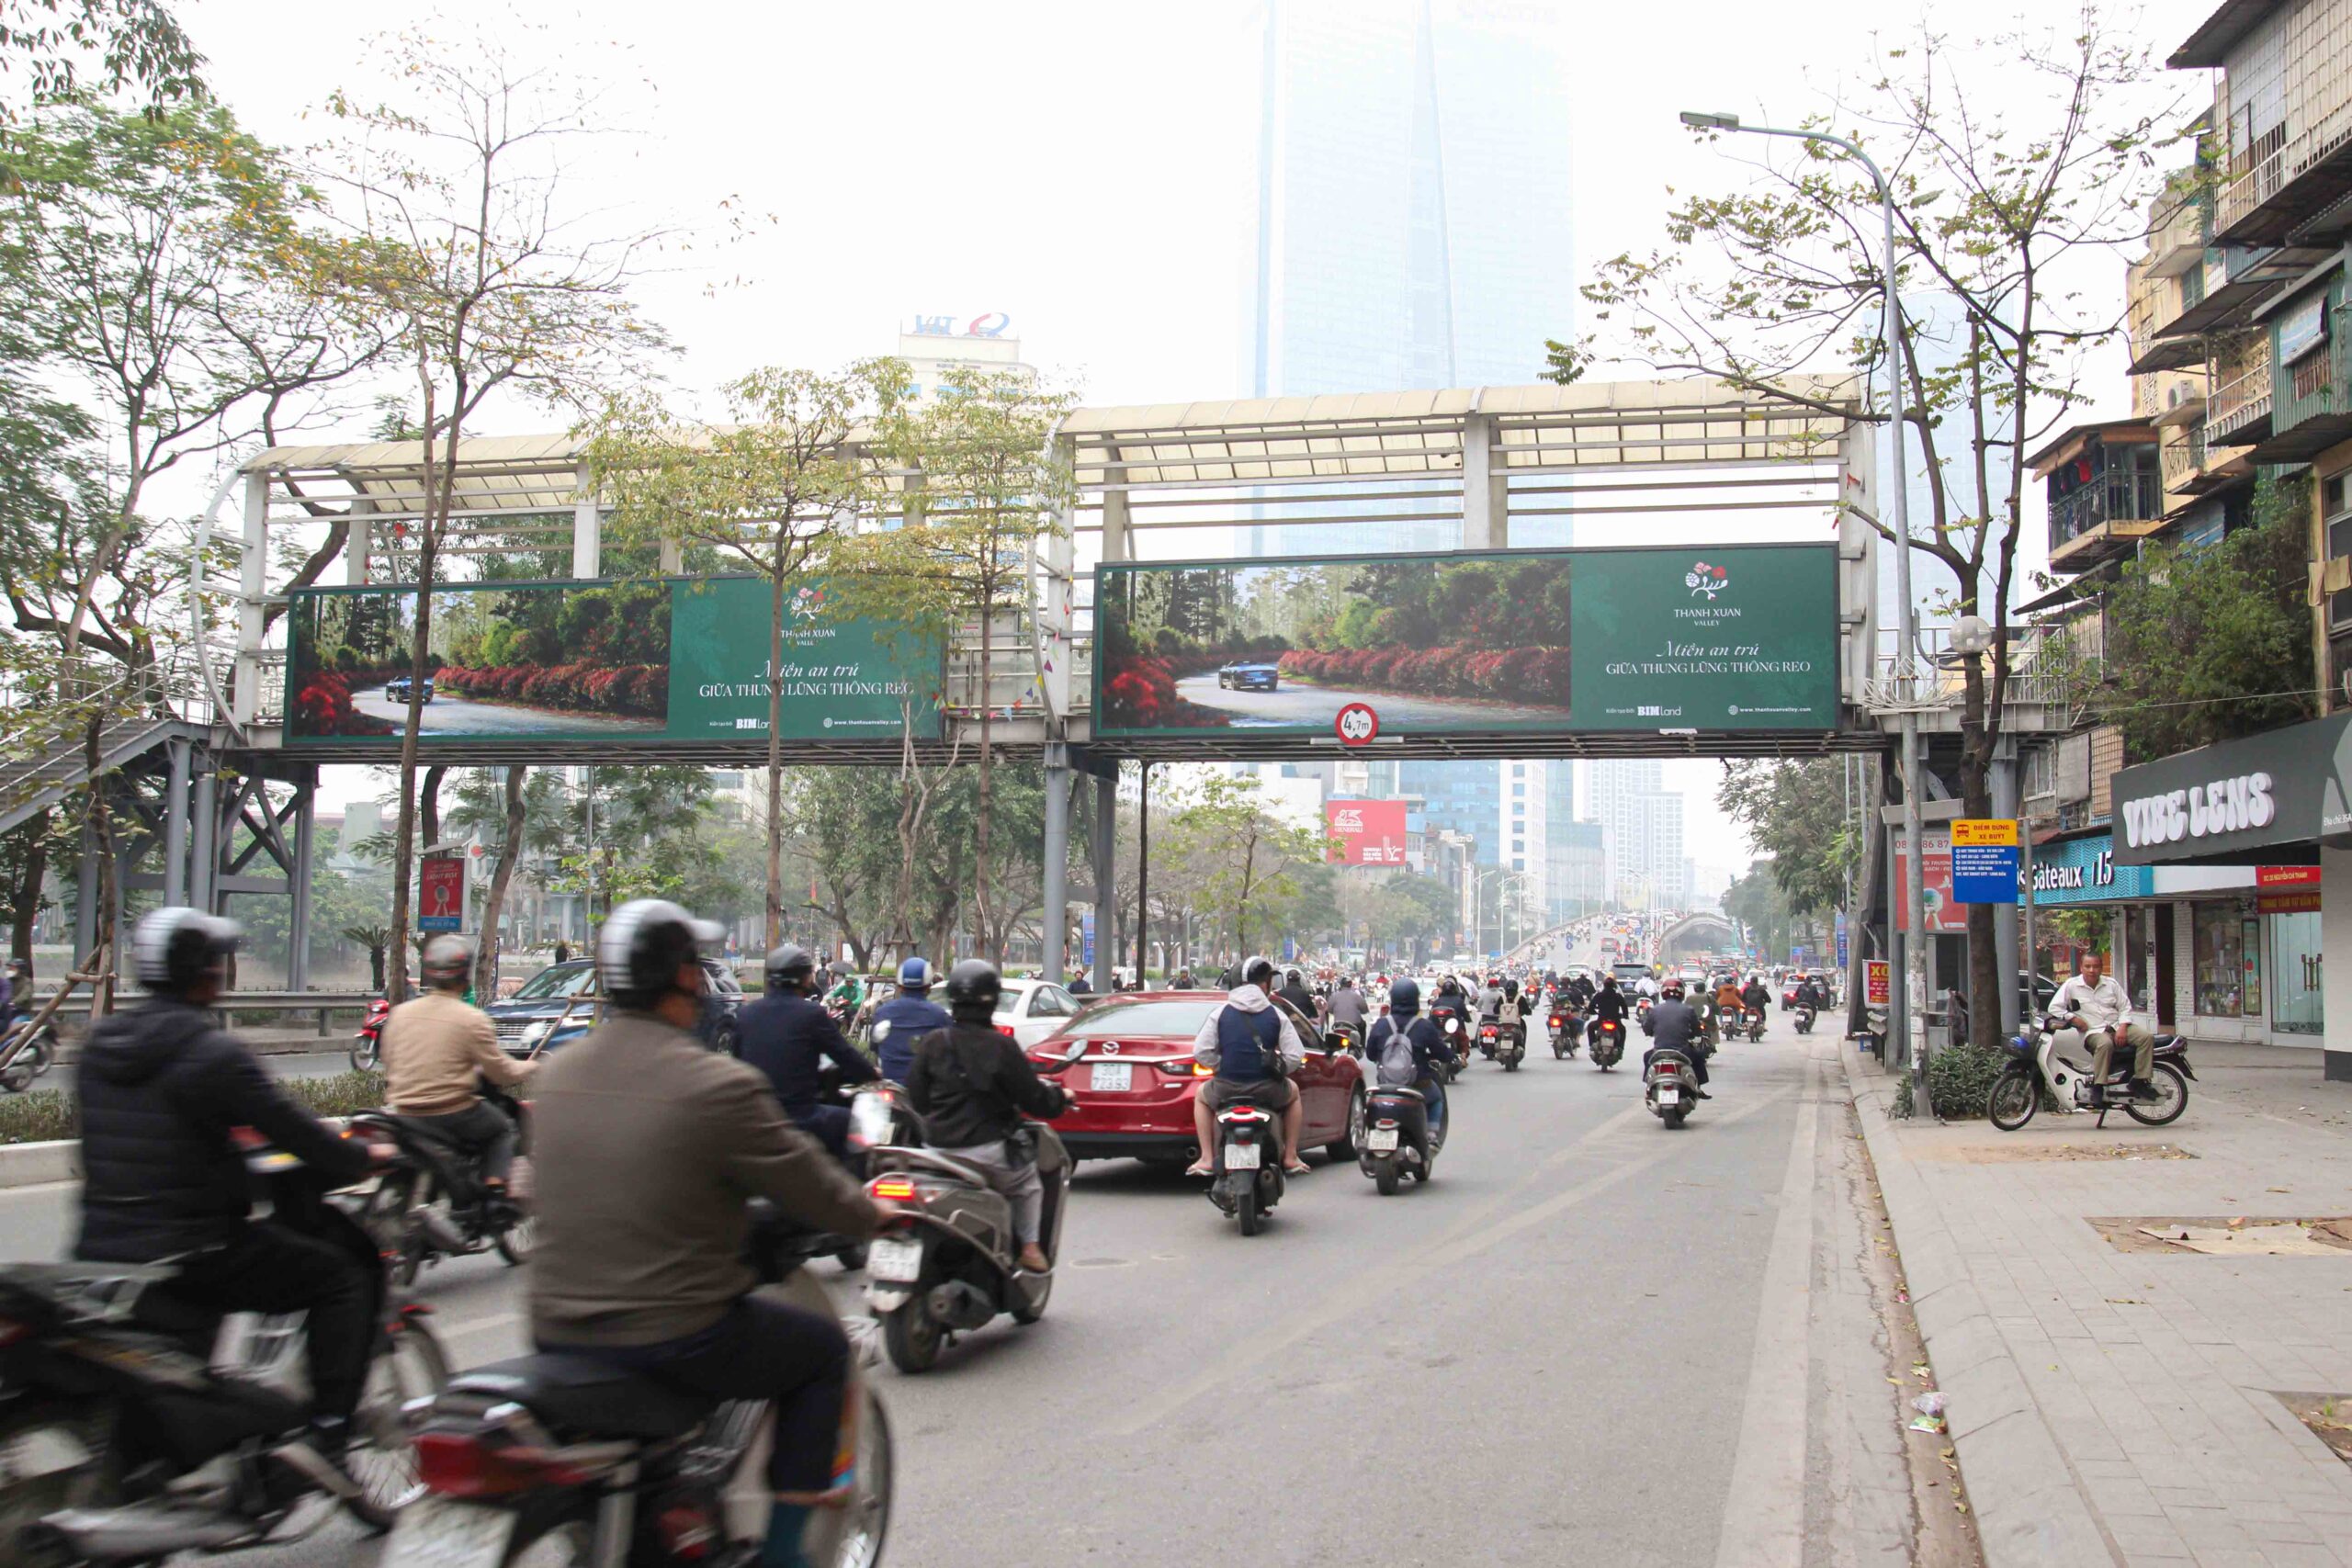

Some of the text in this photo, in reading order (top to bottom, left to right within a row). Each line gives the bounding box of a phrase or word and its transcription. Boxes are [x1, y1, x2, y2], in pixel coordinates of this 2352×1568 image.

[1674, 607, 1742, 618] THANH XUAN
[812, 628, 836, 638] XUAN
[1656, 640, 1760, 657] Miền an trú
[808, 666, 828, 677] an
[833, 662, 859, 677] trú
[1605, 659, 1811, 675] GIỮA THUNG LŨNG THÔNG REO
[699, 682, 733, 697] GIỮA
[787, 682, 827, 696] LŨNG
[830, 681, 882, 695] THÔNG
[2122, 772, 2275, 849] VIBE LENS
[2031, 861, 2084, 891] Gâteaux
